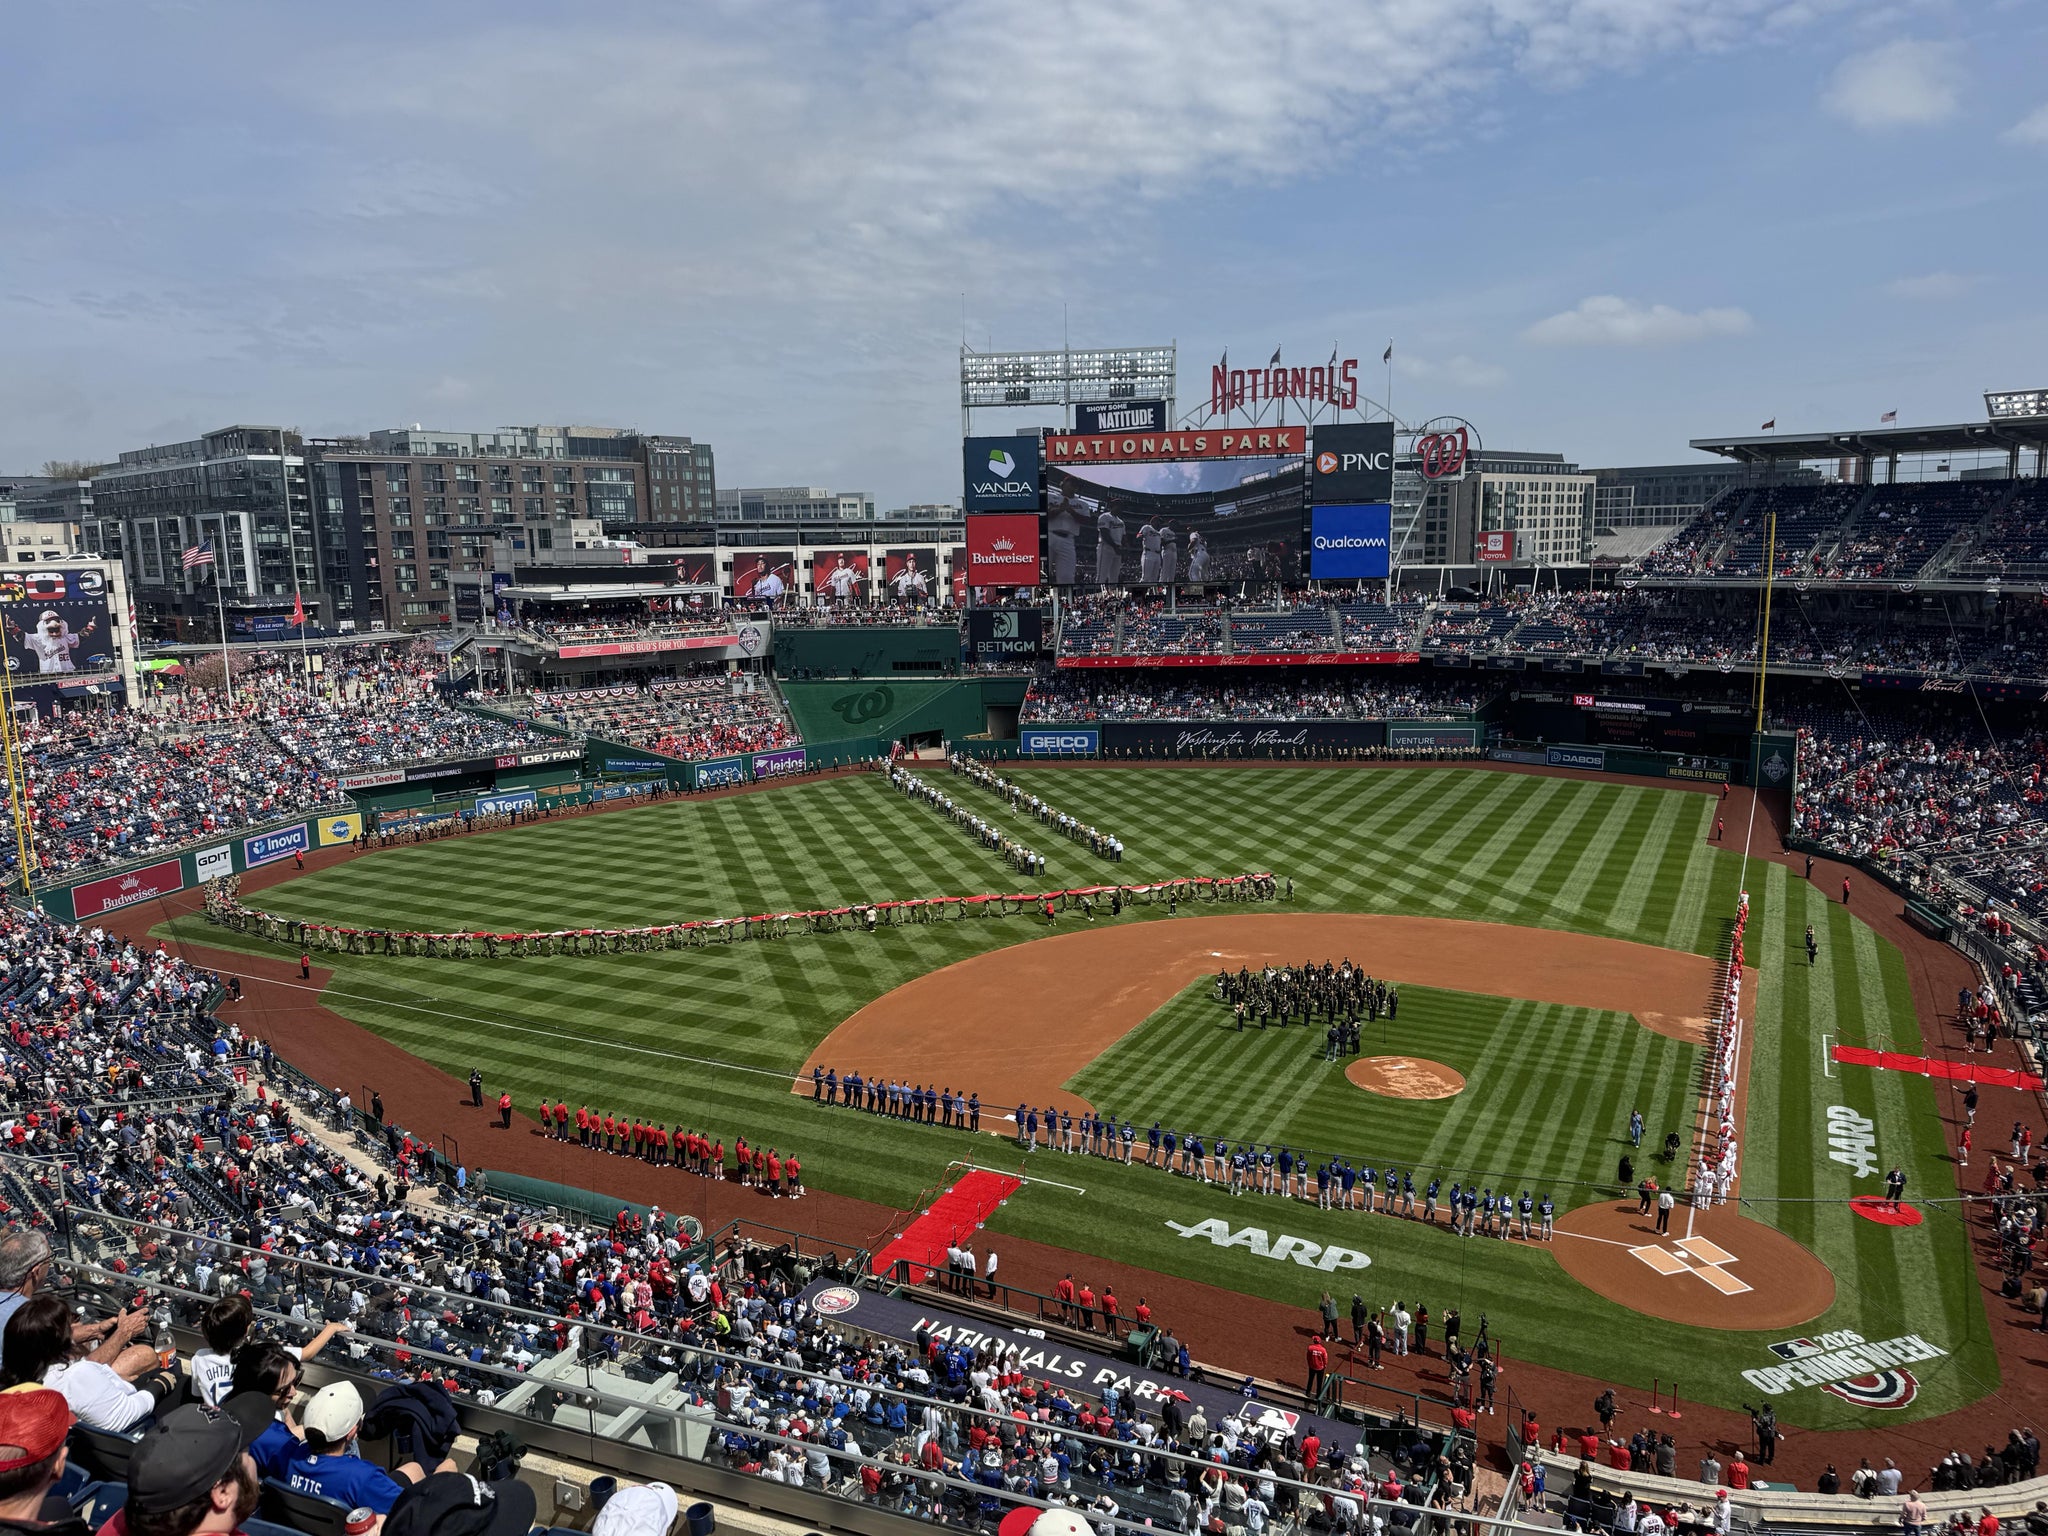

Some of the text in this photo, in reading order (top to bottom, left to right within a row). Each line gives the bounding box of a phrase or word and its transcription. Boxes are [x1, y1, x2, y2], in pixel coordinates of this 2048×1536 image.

[1212, 359, 1358, 415] NATIONALS
[1086, 403, 1128, 413] SHOW SOME
[1098, 408, 1155, 429] NATITUDE
[1055, 432, 1291, 456] NATIONALS PARK
[1341, 452, 1389, 471] PNC
[972, 481, 1033, 494] VANDA
[1314, 535, 1386, 550] Qualcomm
[972, 552, 1035, 564] Budweiser
[618, 640, 689, 653] THIS BUD'S FOR YOU.
[977, 641, 1035, 653] BETMGM
[1575, 695, 1593, 706] 12:54
[1176, 727, 1308, 753] Washington Nationals
[1664, 728, 1696, 738] verizon
[1030, 736, 1089, 748] GEICO
[1395, 736, 1435, 745] VENTURE
[552, 749, 581, 761] FAN
[1562, 755, 1602, 765] DABOS
[497, 757, 516, 769] 12:54
[770, 754, 803, 773] leidos
[407, 771, 435, 782] WASHINGTON
[709, 766, 741, 779] VANDA
[1669, 767, 1728, 781] HERCULES FENCE
[346, 772, 403, 788] Harris Teeter
[495, 797, 533, 811] Terra
[267, 832, 301, 851] Inova
[198, 850, 230, 867] GDIT
[1827, 1105, 1880, 1179] AARP
[1164, 1217, 1372, 1273] AARP
[693, 1278, 702, 1287] 42
[1812, 1329, 1866, 1351] 2026
[1741, 1333, 1950, 1395] OPENING WEEK
